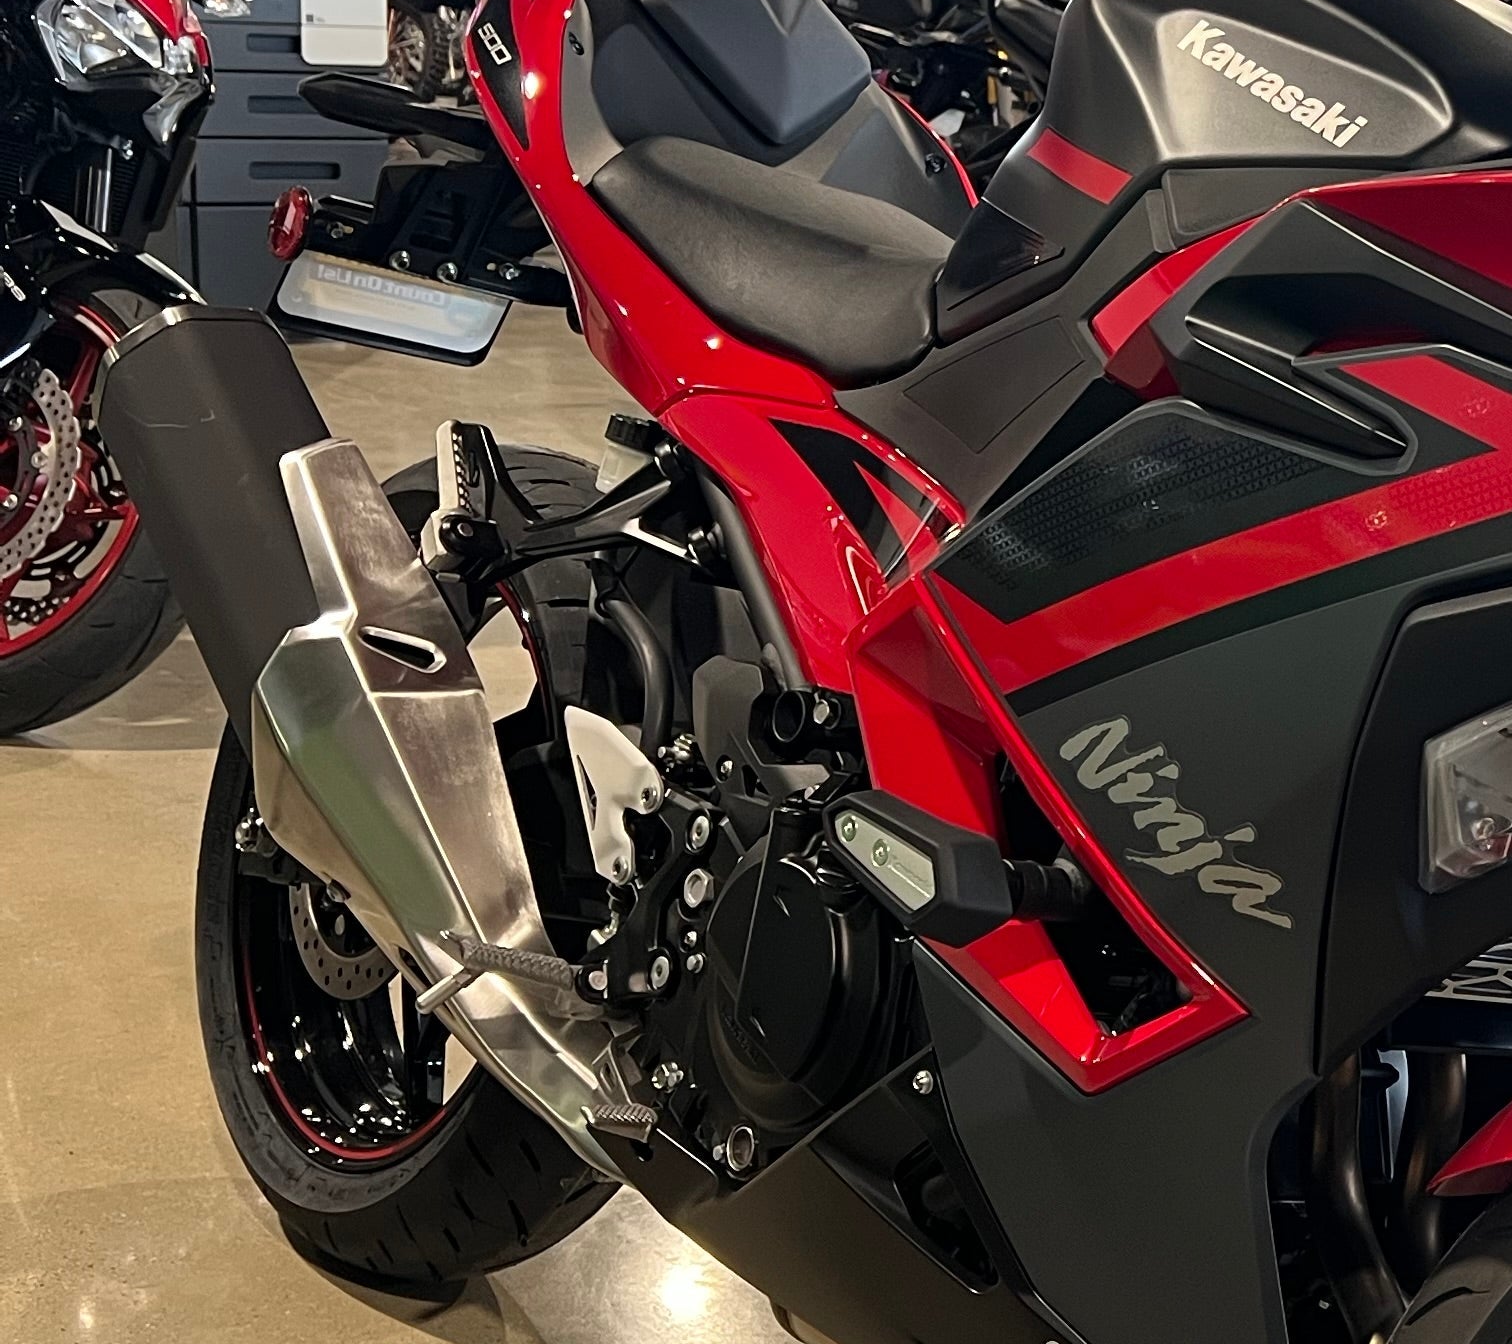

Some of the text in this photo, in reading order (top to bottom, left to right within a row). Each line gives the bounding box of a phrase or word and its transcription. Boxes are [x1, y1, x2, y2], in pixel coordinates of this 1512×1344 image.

[477, 22, 513, 65] 500
[1176, 19, 1369, 148] Kawasaki
[1058, 717, 1294, 930] Ninja
